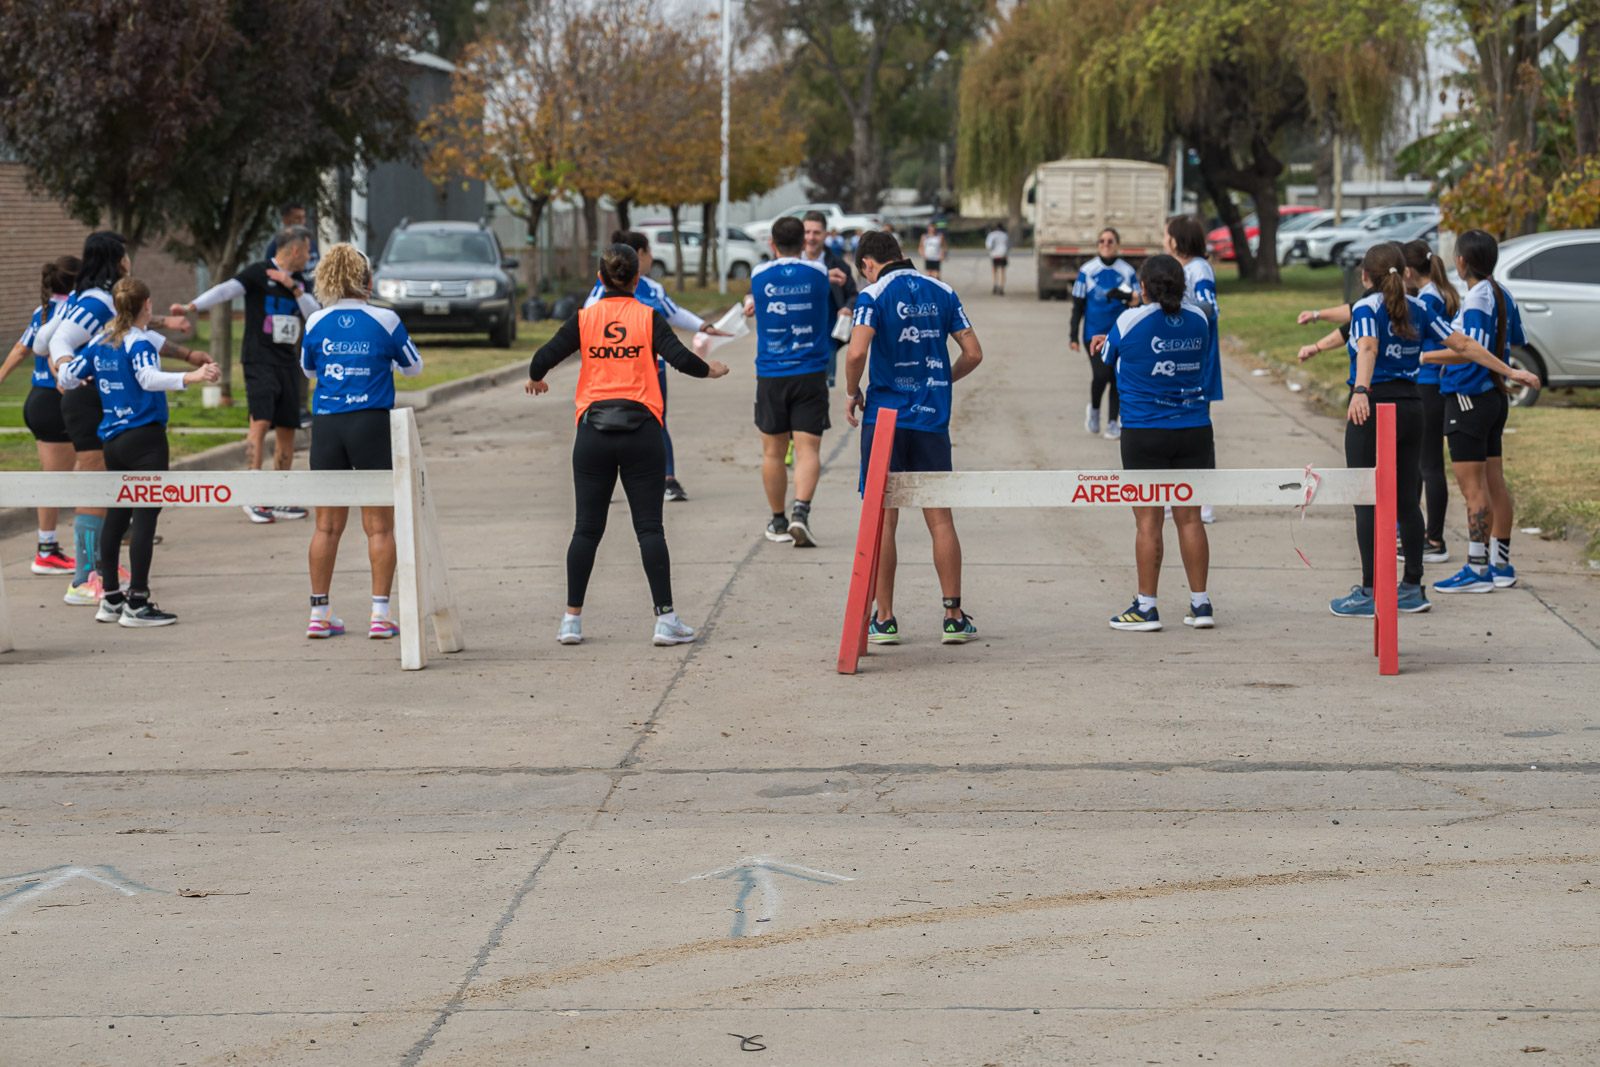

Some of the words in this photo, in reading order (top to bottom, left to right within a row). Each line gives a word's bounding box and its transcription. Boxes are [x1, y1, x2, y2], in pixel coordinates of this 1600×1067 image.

[898, 326, 920, 343] AQ
[322, 338, 370, 356] CEDAR
[1151, 336, 1202, 354] CEDAR
[324, 363, 344, 380] AQ
[1151, 360, 1176, 377] AQ
[116, 485, 232, 503] AREQUITO
[1071, 483, 1193, 503] AREQUITO
